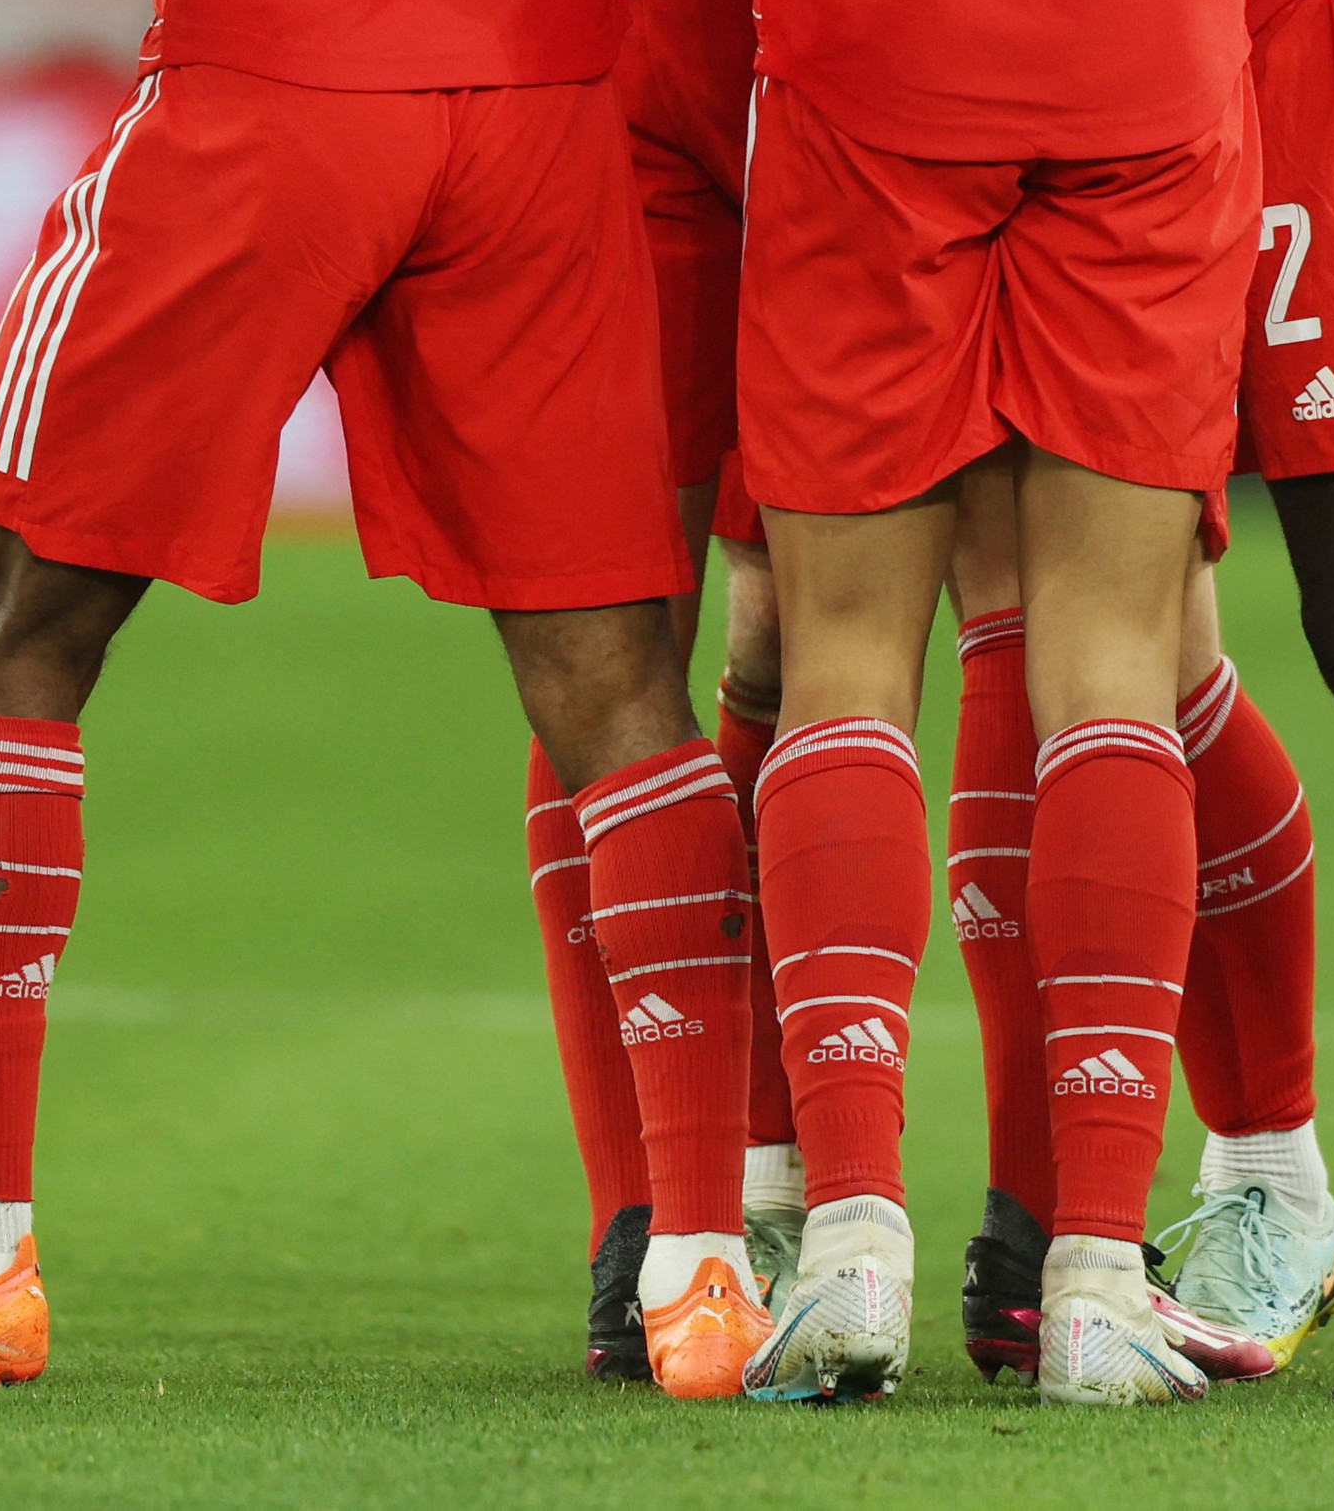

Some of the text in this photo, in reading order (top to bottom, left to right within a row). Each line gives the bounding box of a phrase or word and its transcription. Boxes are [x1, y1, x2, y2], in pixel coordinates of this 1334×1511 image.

[1259, 202, 1323, 347] 2
[954, 918, 1019, 943] idas
[621, 1019, 705, 1046] didas
[806, 1042, 906, 1074] adidas
[1054, 1075, 1158, 1100] adidas
